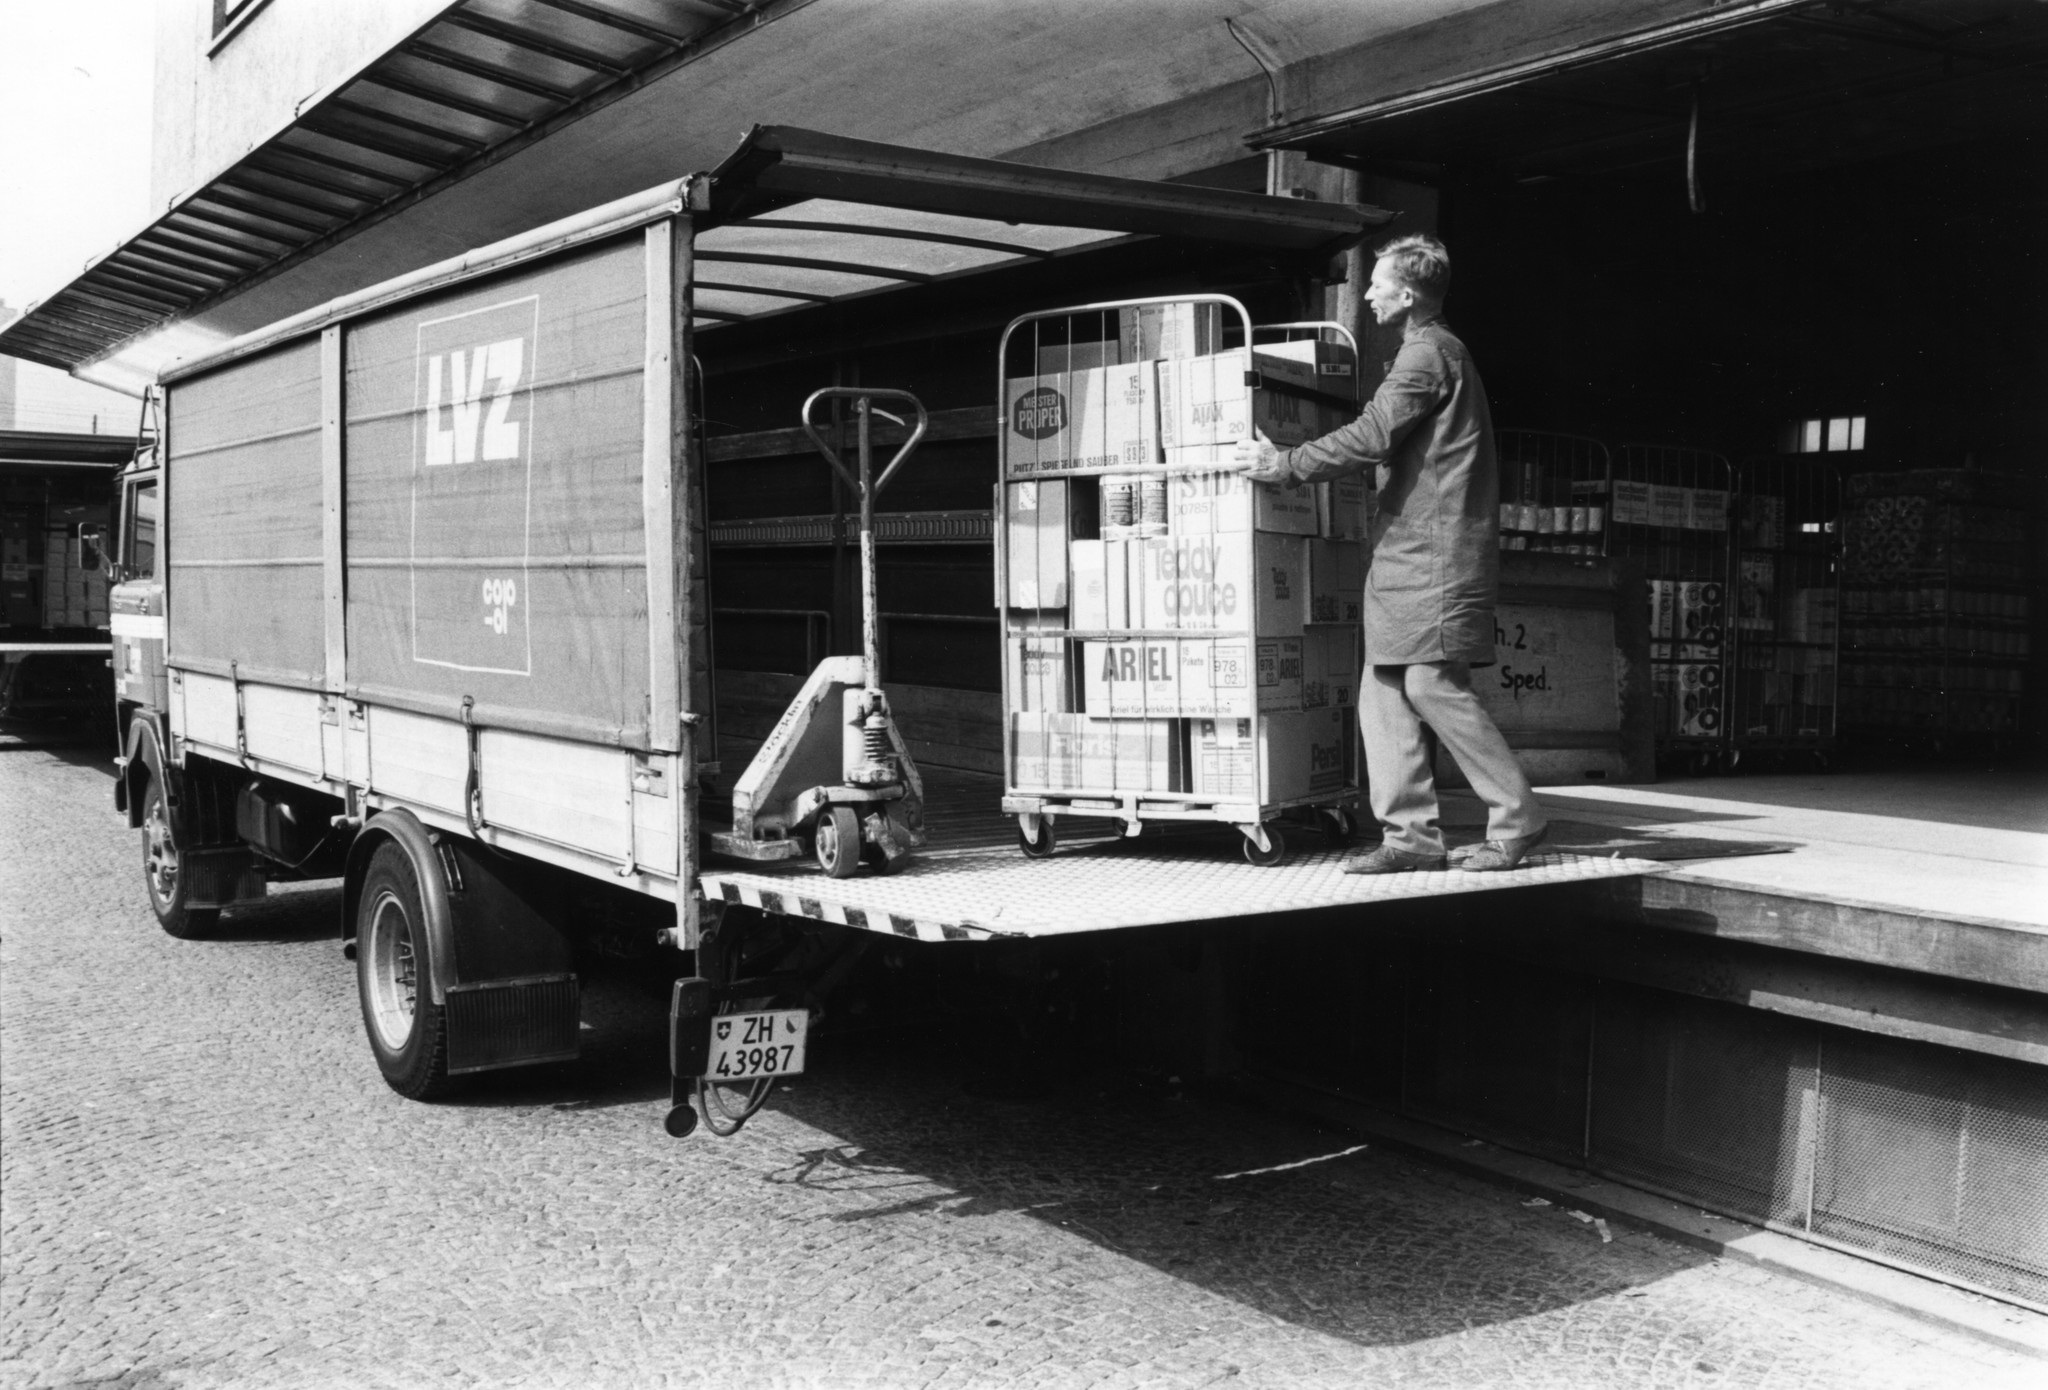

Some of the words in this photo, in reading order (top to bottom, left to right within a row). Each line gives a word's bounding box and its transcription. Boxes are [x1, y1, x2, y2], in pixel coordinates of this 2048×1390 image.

[426, 337, 524, 466] LVZ
[1023, 394, 1057, 409] MESTER
[1229, 421, 1245, 434] 20
[1147, 538, 1221, 583] Teddy
[1102, 647, 1174, 683] ARIEL
[1501, 665, 1551, 700] Sped.
[1179, 705, 1197, 713] eine
[742, 1015, 774, 1045] ZH
[716, 1045, 795, 1077] 43987
